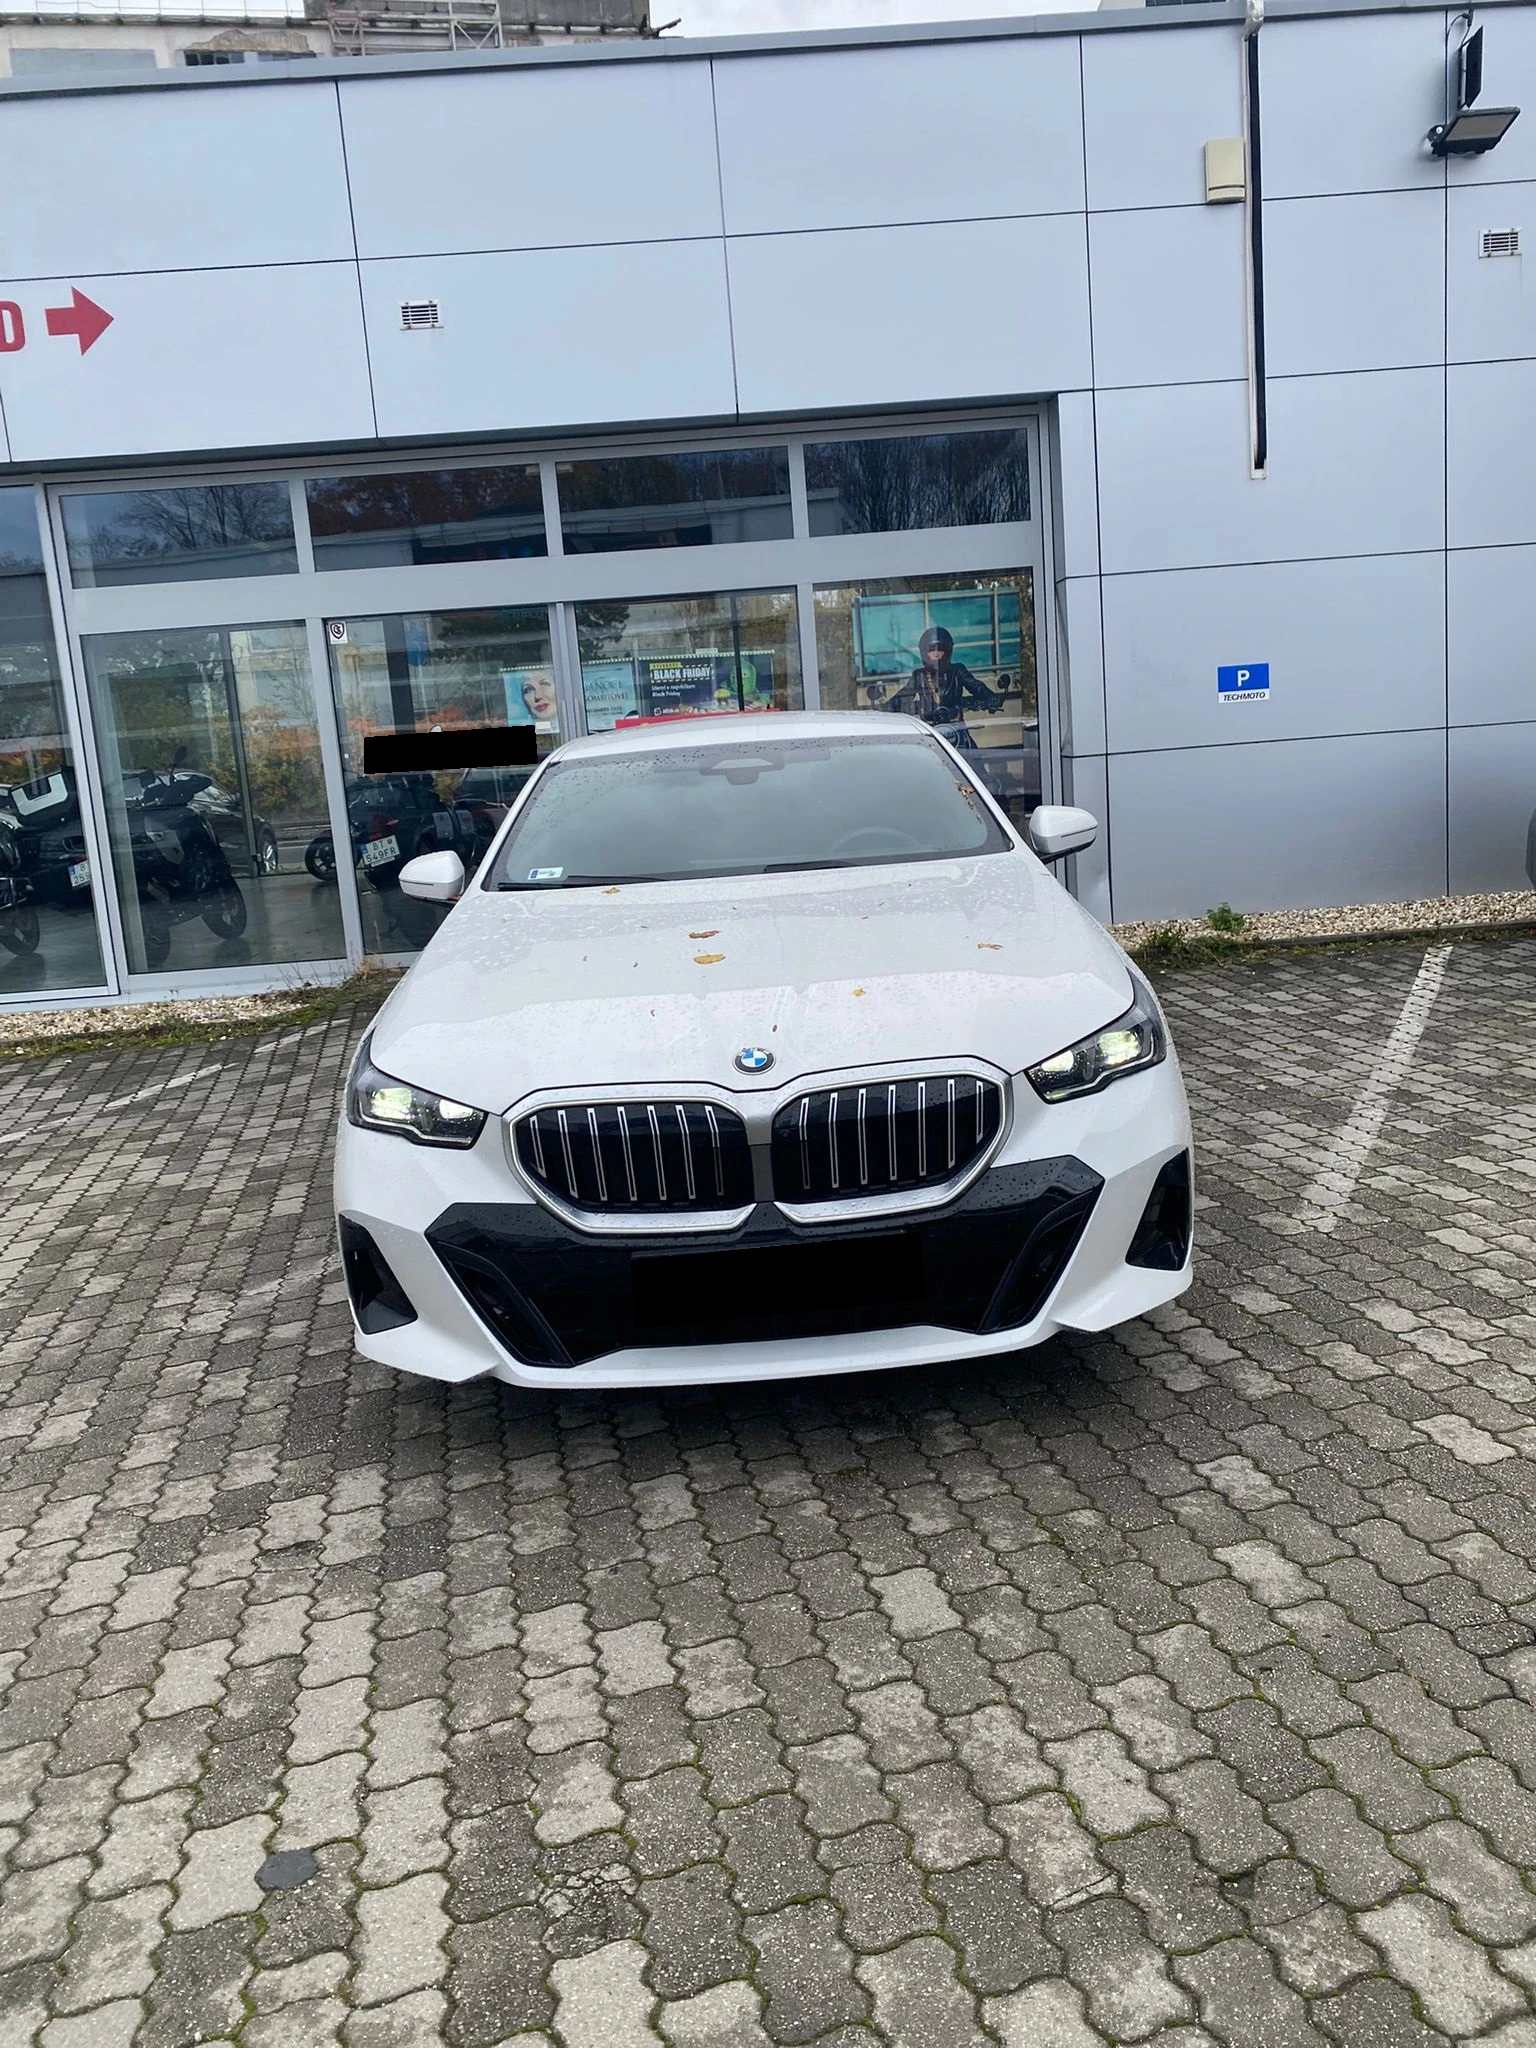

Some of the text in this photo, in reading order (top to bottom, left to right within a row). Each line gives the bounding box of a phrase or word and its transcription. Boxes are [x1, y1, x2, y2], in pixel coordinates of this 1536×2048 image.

[654, 667, 711, 680] BLACK FRIDAY
[1237, 670, 1250, 687] P
[1223, 691, 1266, 701] TECHMOTO
